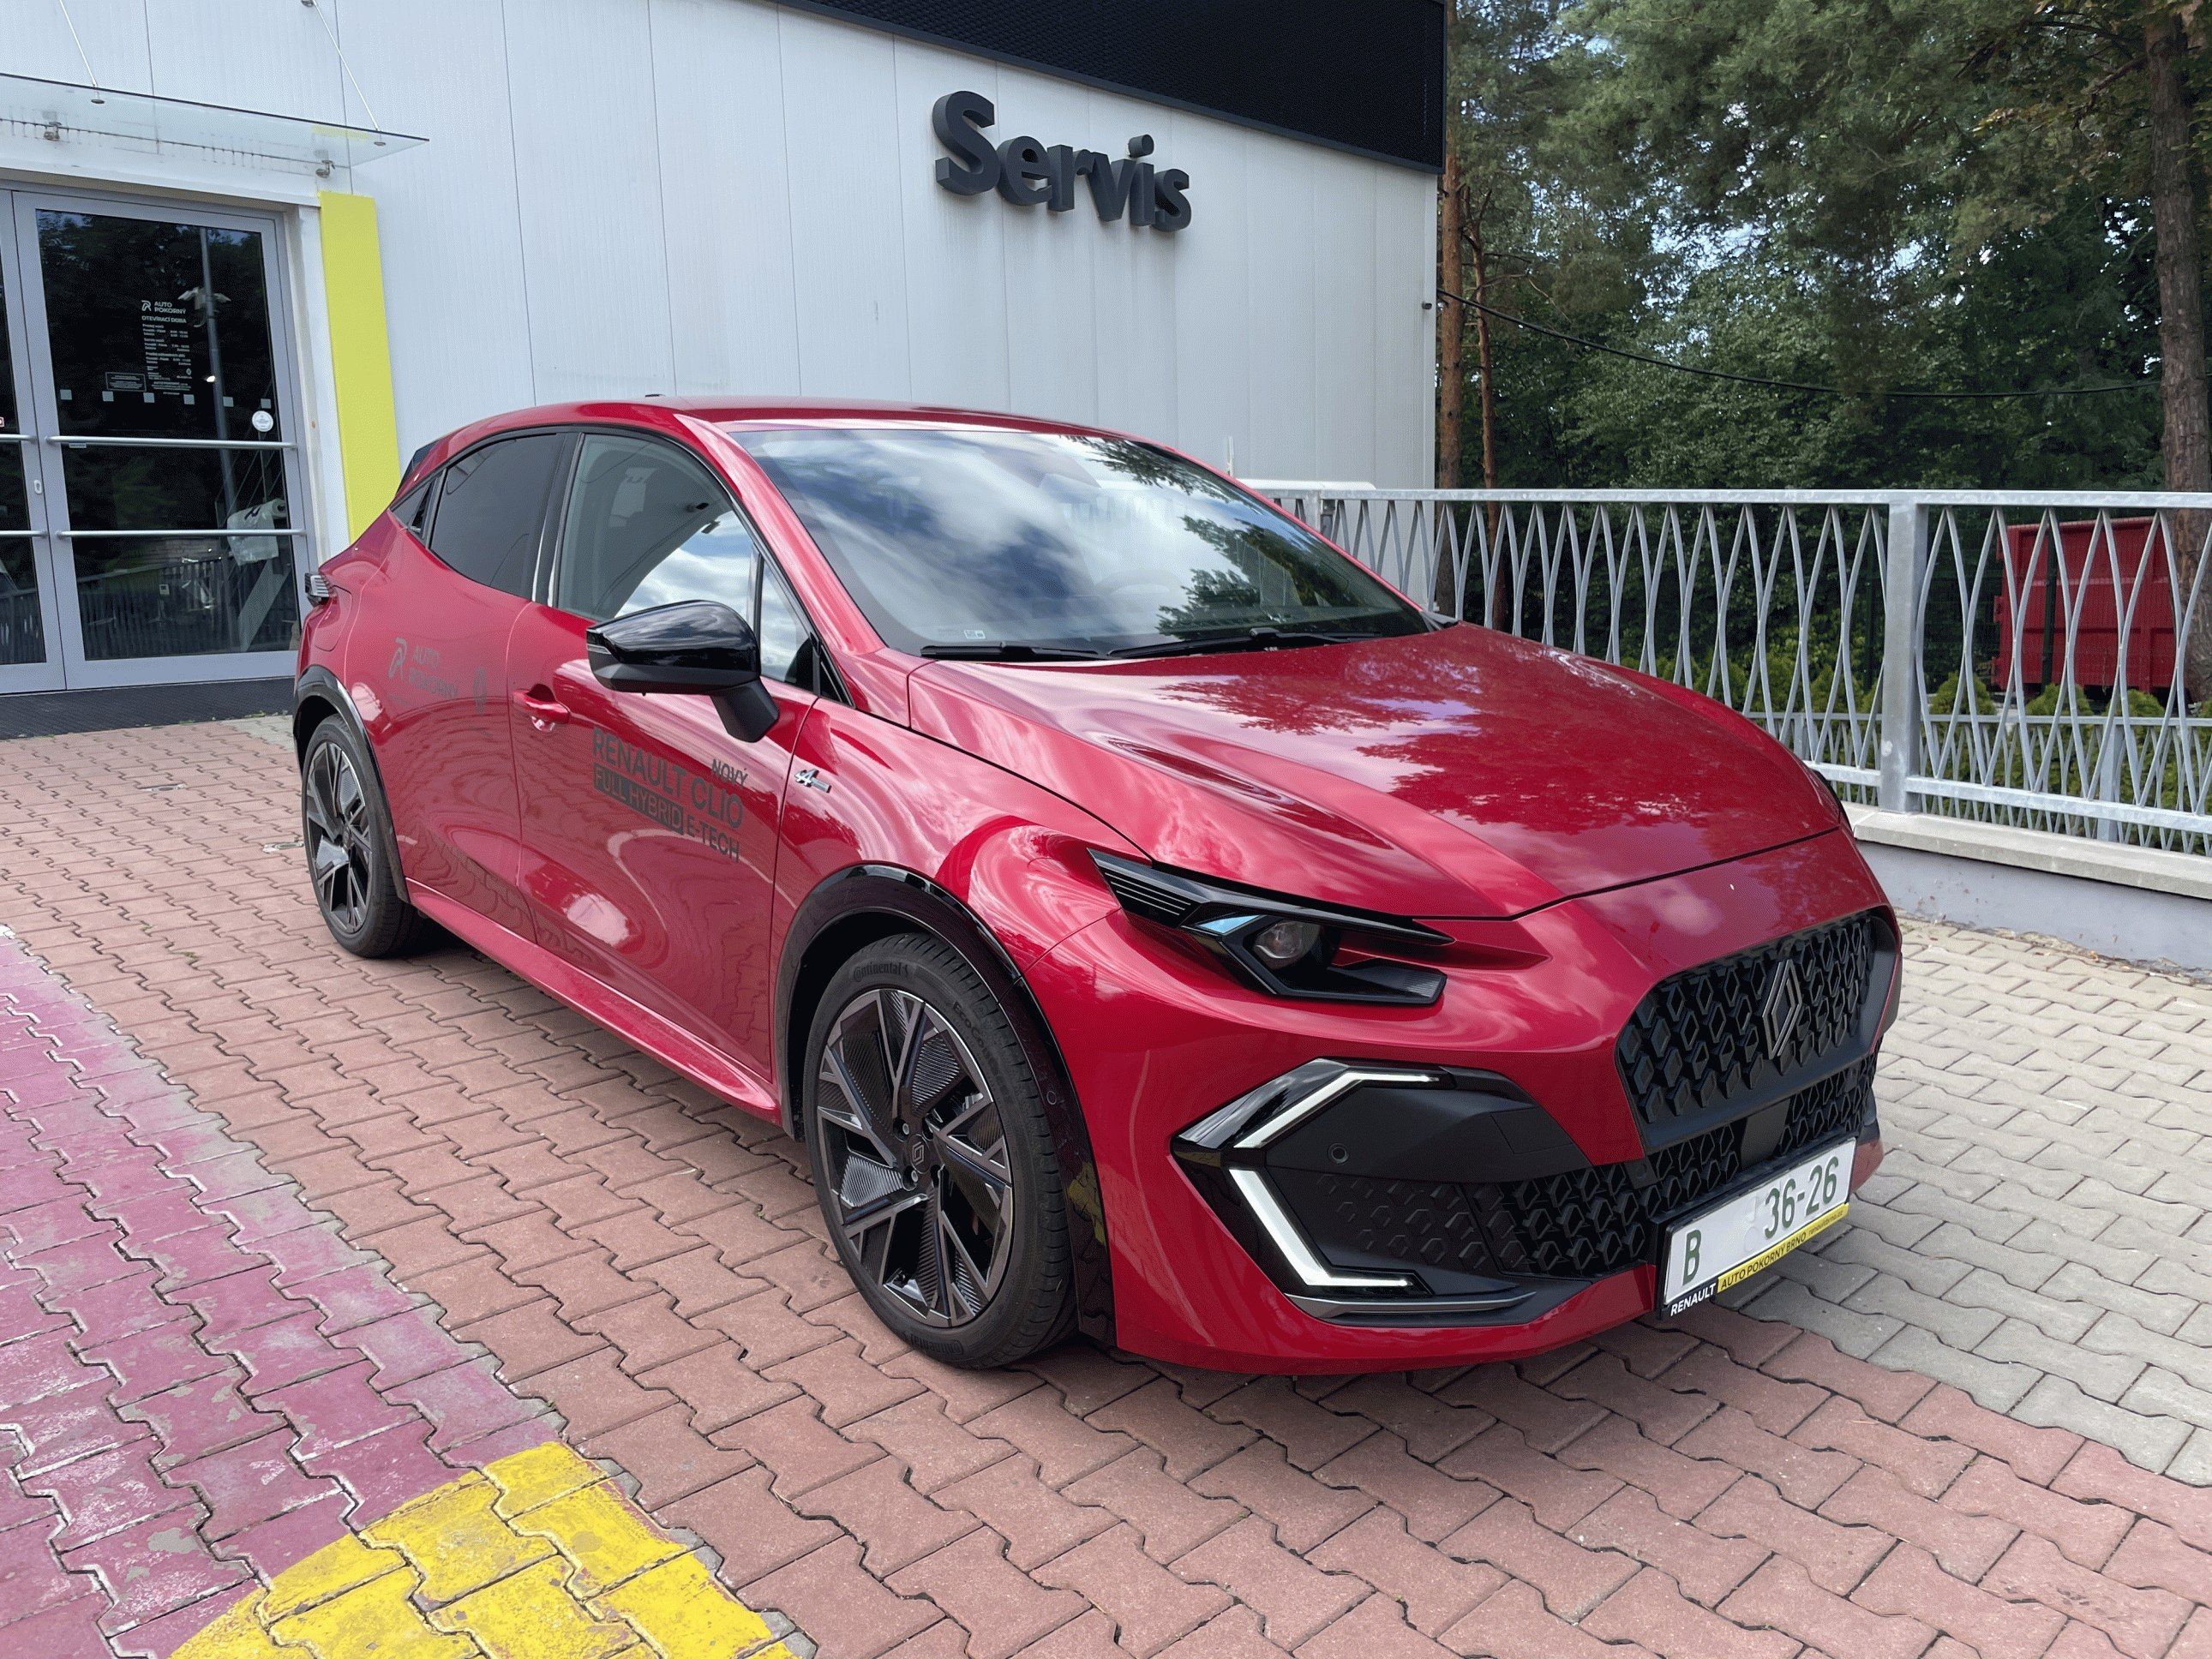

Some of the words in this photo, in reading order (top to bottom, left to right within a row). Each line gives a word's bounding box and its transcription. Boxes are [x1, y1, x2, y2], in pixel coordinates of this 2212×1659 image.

[932, 91, 1192, 232] Servis
[592, 728, 687, 799] RENAULT
[691, 776, 745, 829] CLIO
[596, 768, 626, 800] FULL
[632, 785, 682, 830] HYBRID
[687, 815, 740, 862] E-TECH
[711, 758, 748, 786] NOVÝ
[1682, 1229, 1702, 1286] B
[1765, 1155, 1839, 1240] 36-26
[1721, 1268, 1746, 1290] AUTO
[1786, 1231, 1807, 1254] BRNO
[1670, 1282, 1717, 1316] RENAULT
